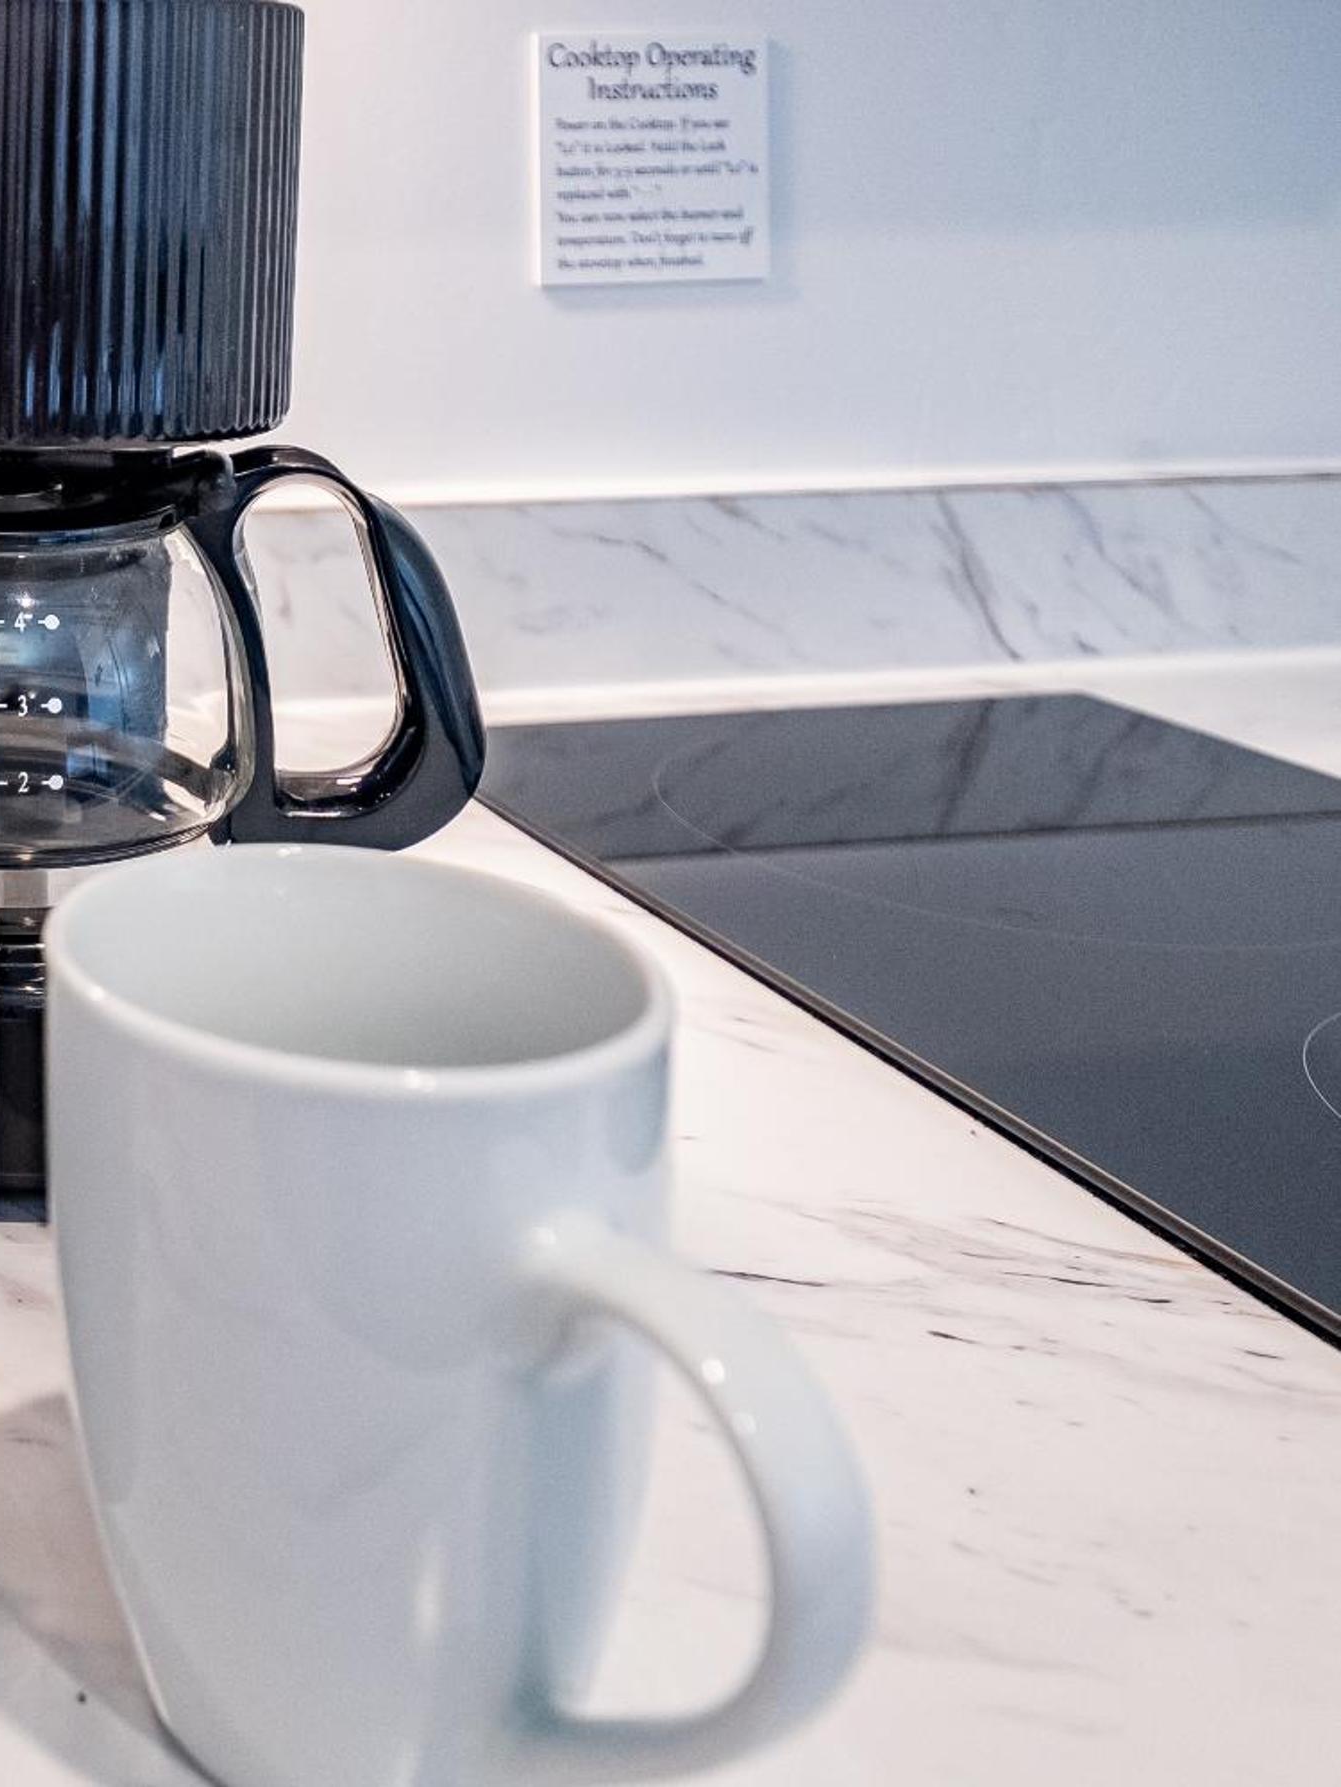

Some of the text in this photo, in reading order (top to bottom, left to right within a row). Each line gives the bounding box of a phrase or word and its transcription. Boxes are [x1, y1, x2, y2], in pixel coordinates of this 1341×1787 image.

[548, 39, 757, 76] Cooktop Operating
[587, 76, 719, 101] Instructions
[14, 612, 28, 632] 4
[18, 694, 28, 716] 3
[18, 771, 29, 793] 2
